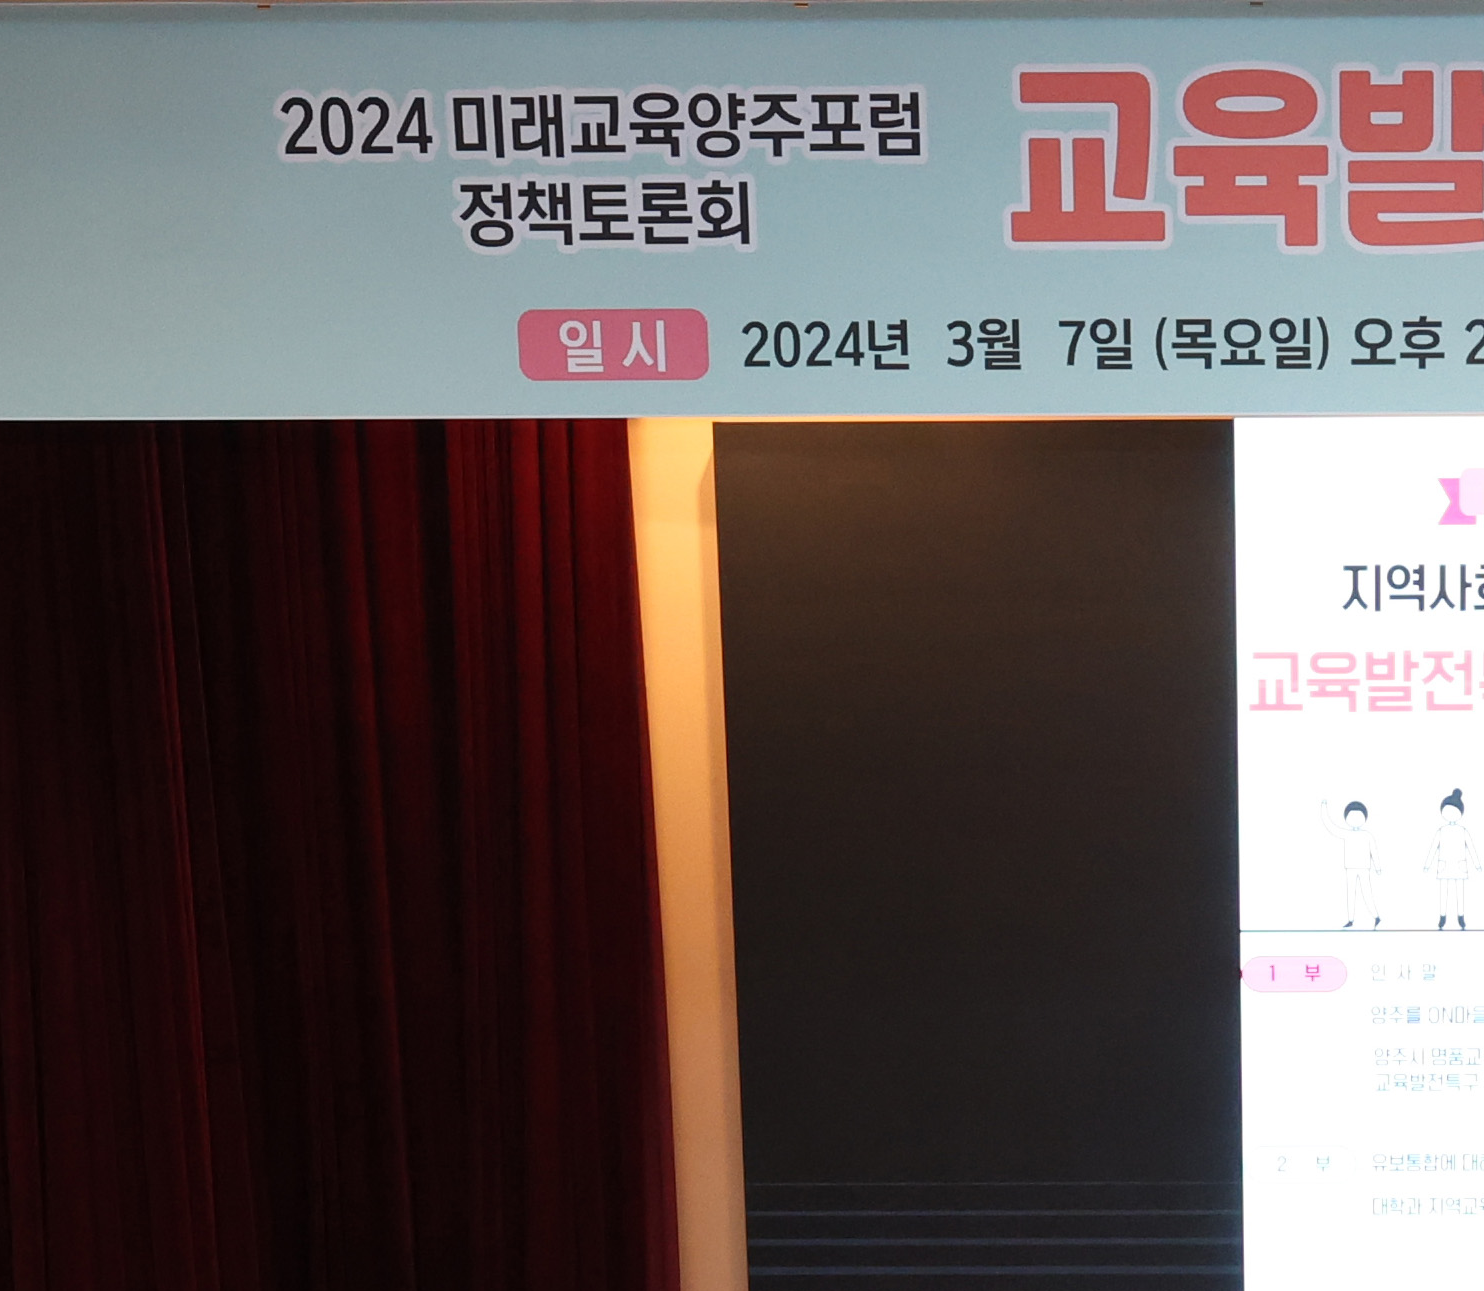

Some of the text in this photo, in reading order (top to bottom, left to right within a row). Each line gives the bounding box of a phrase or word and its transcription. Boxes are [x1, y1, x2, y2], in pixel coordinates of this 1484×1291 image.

[283, 91, 925, 162] 2024 미래교육양주포럼
[457, 178, 755, 248] 정책토론회
[742, 319, 913, 373] 2024년
[947, 316, 1025, 373] 3월
[1059, 316, 1136, 373] 7일
[1154, 312, 1329, 375] (목요일)
[1350, 314, 1447, 373] 오후
